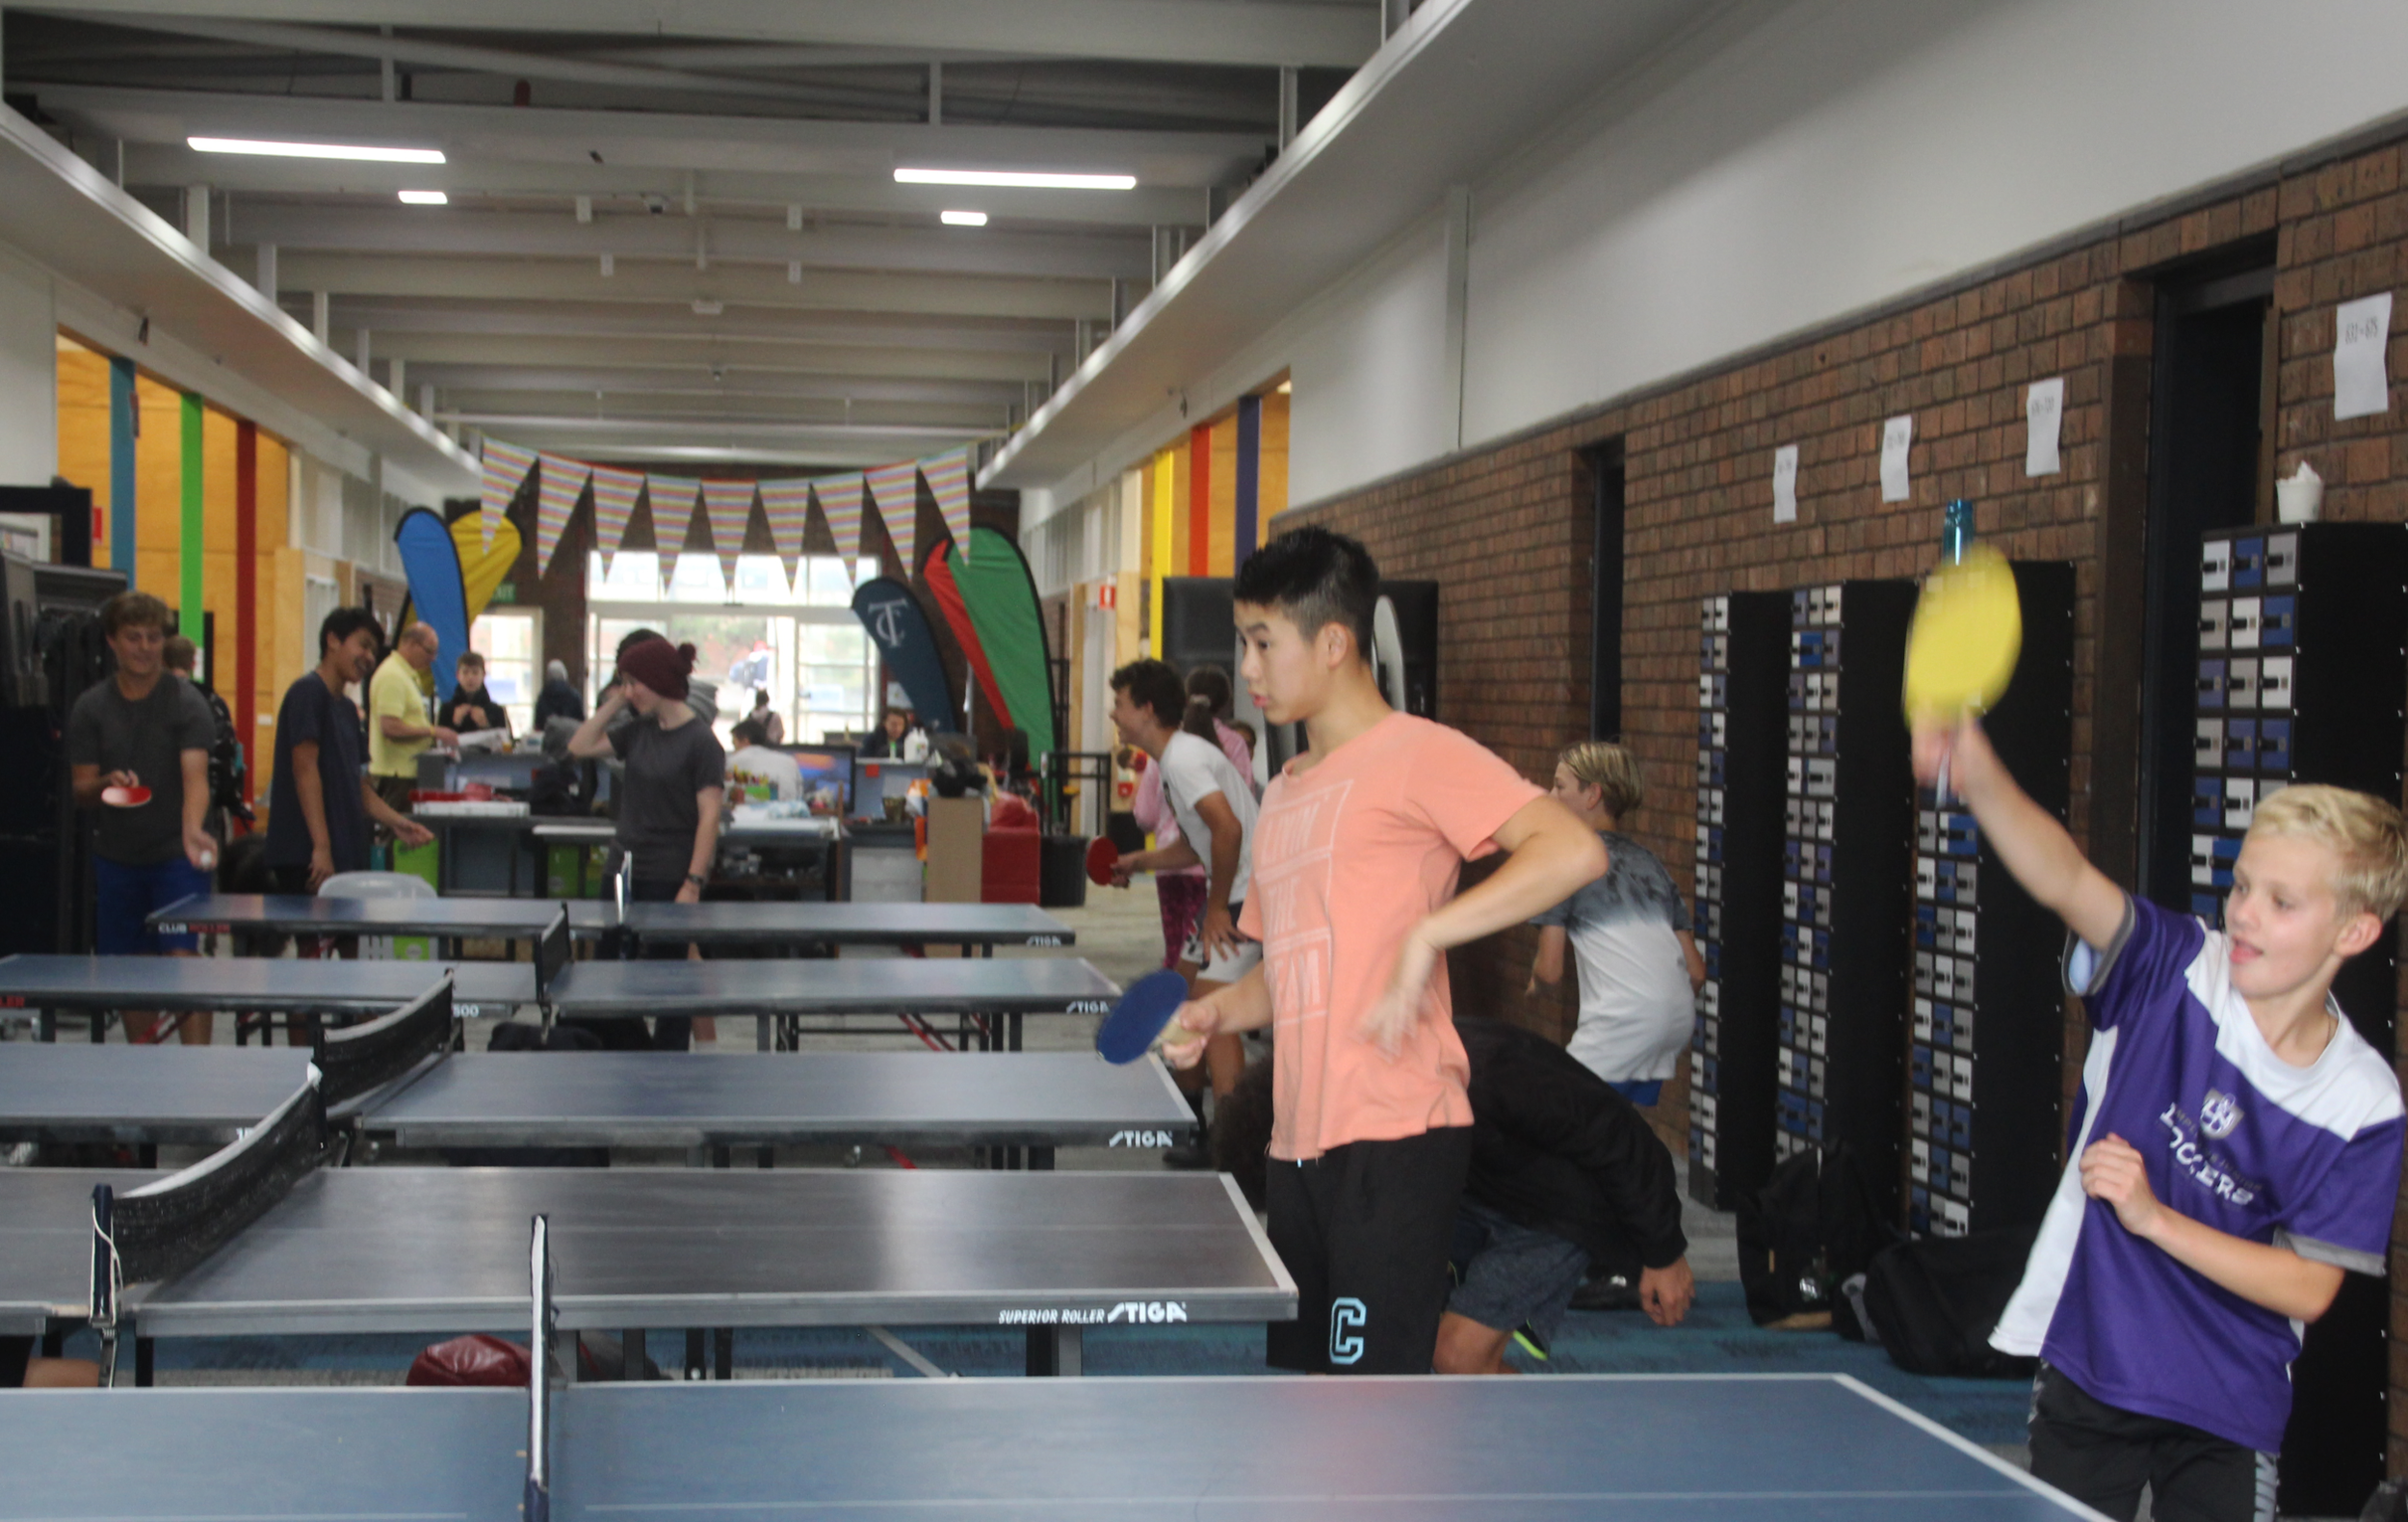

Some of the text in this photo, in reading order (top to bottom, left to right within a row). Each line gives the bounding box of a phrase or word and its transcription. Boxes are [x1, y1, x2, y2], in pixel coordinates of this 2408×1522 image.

[158, 922, 188, 934] CLUB
[1065, 1000, 1111, 1014] STIGA
[1109, 1129, 1173, 1148] STIGA
[998, 1300, 1188, 1325] SUPERIOR ROLLER STIGA
[1329, 1296, 1367, 1365] C
